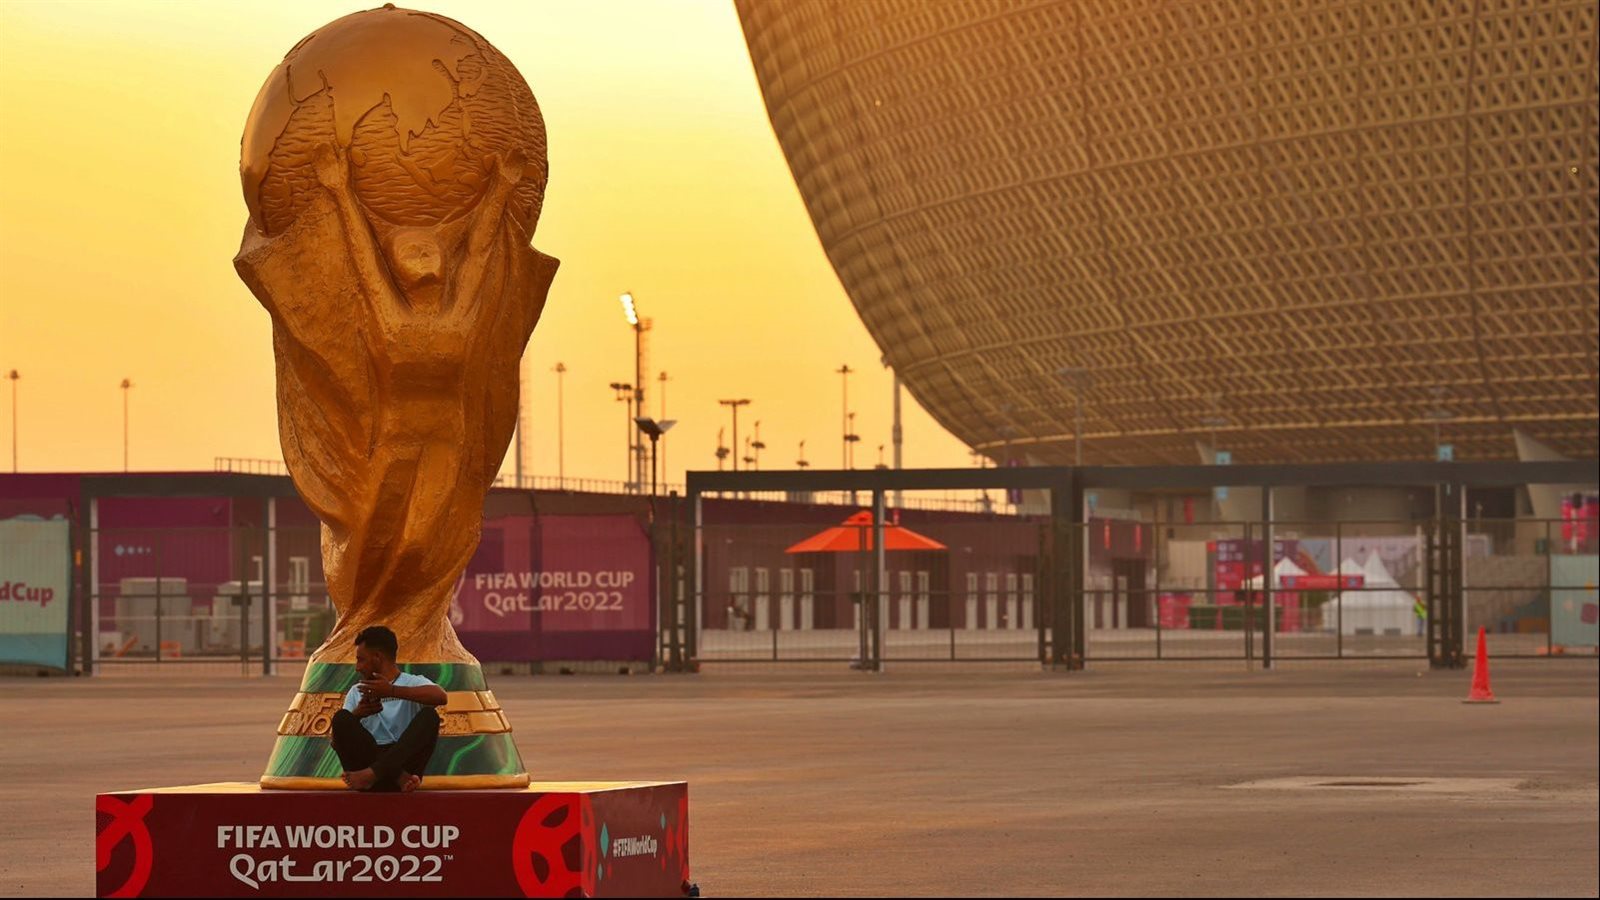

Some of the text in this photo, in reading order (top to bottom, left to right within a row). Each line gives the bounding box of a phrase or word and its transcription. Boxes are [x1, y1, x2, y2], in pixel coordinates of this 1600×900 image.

[475, 571, 635, 590] FIFA WORLD CUP
[217, 825, 460, 849] FIFA WORLD CUP
[613, 834, 658, 858] #FIFAWorldCup
